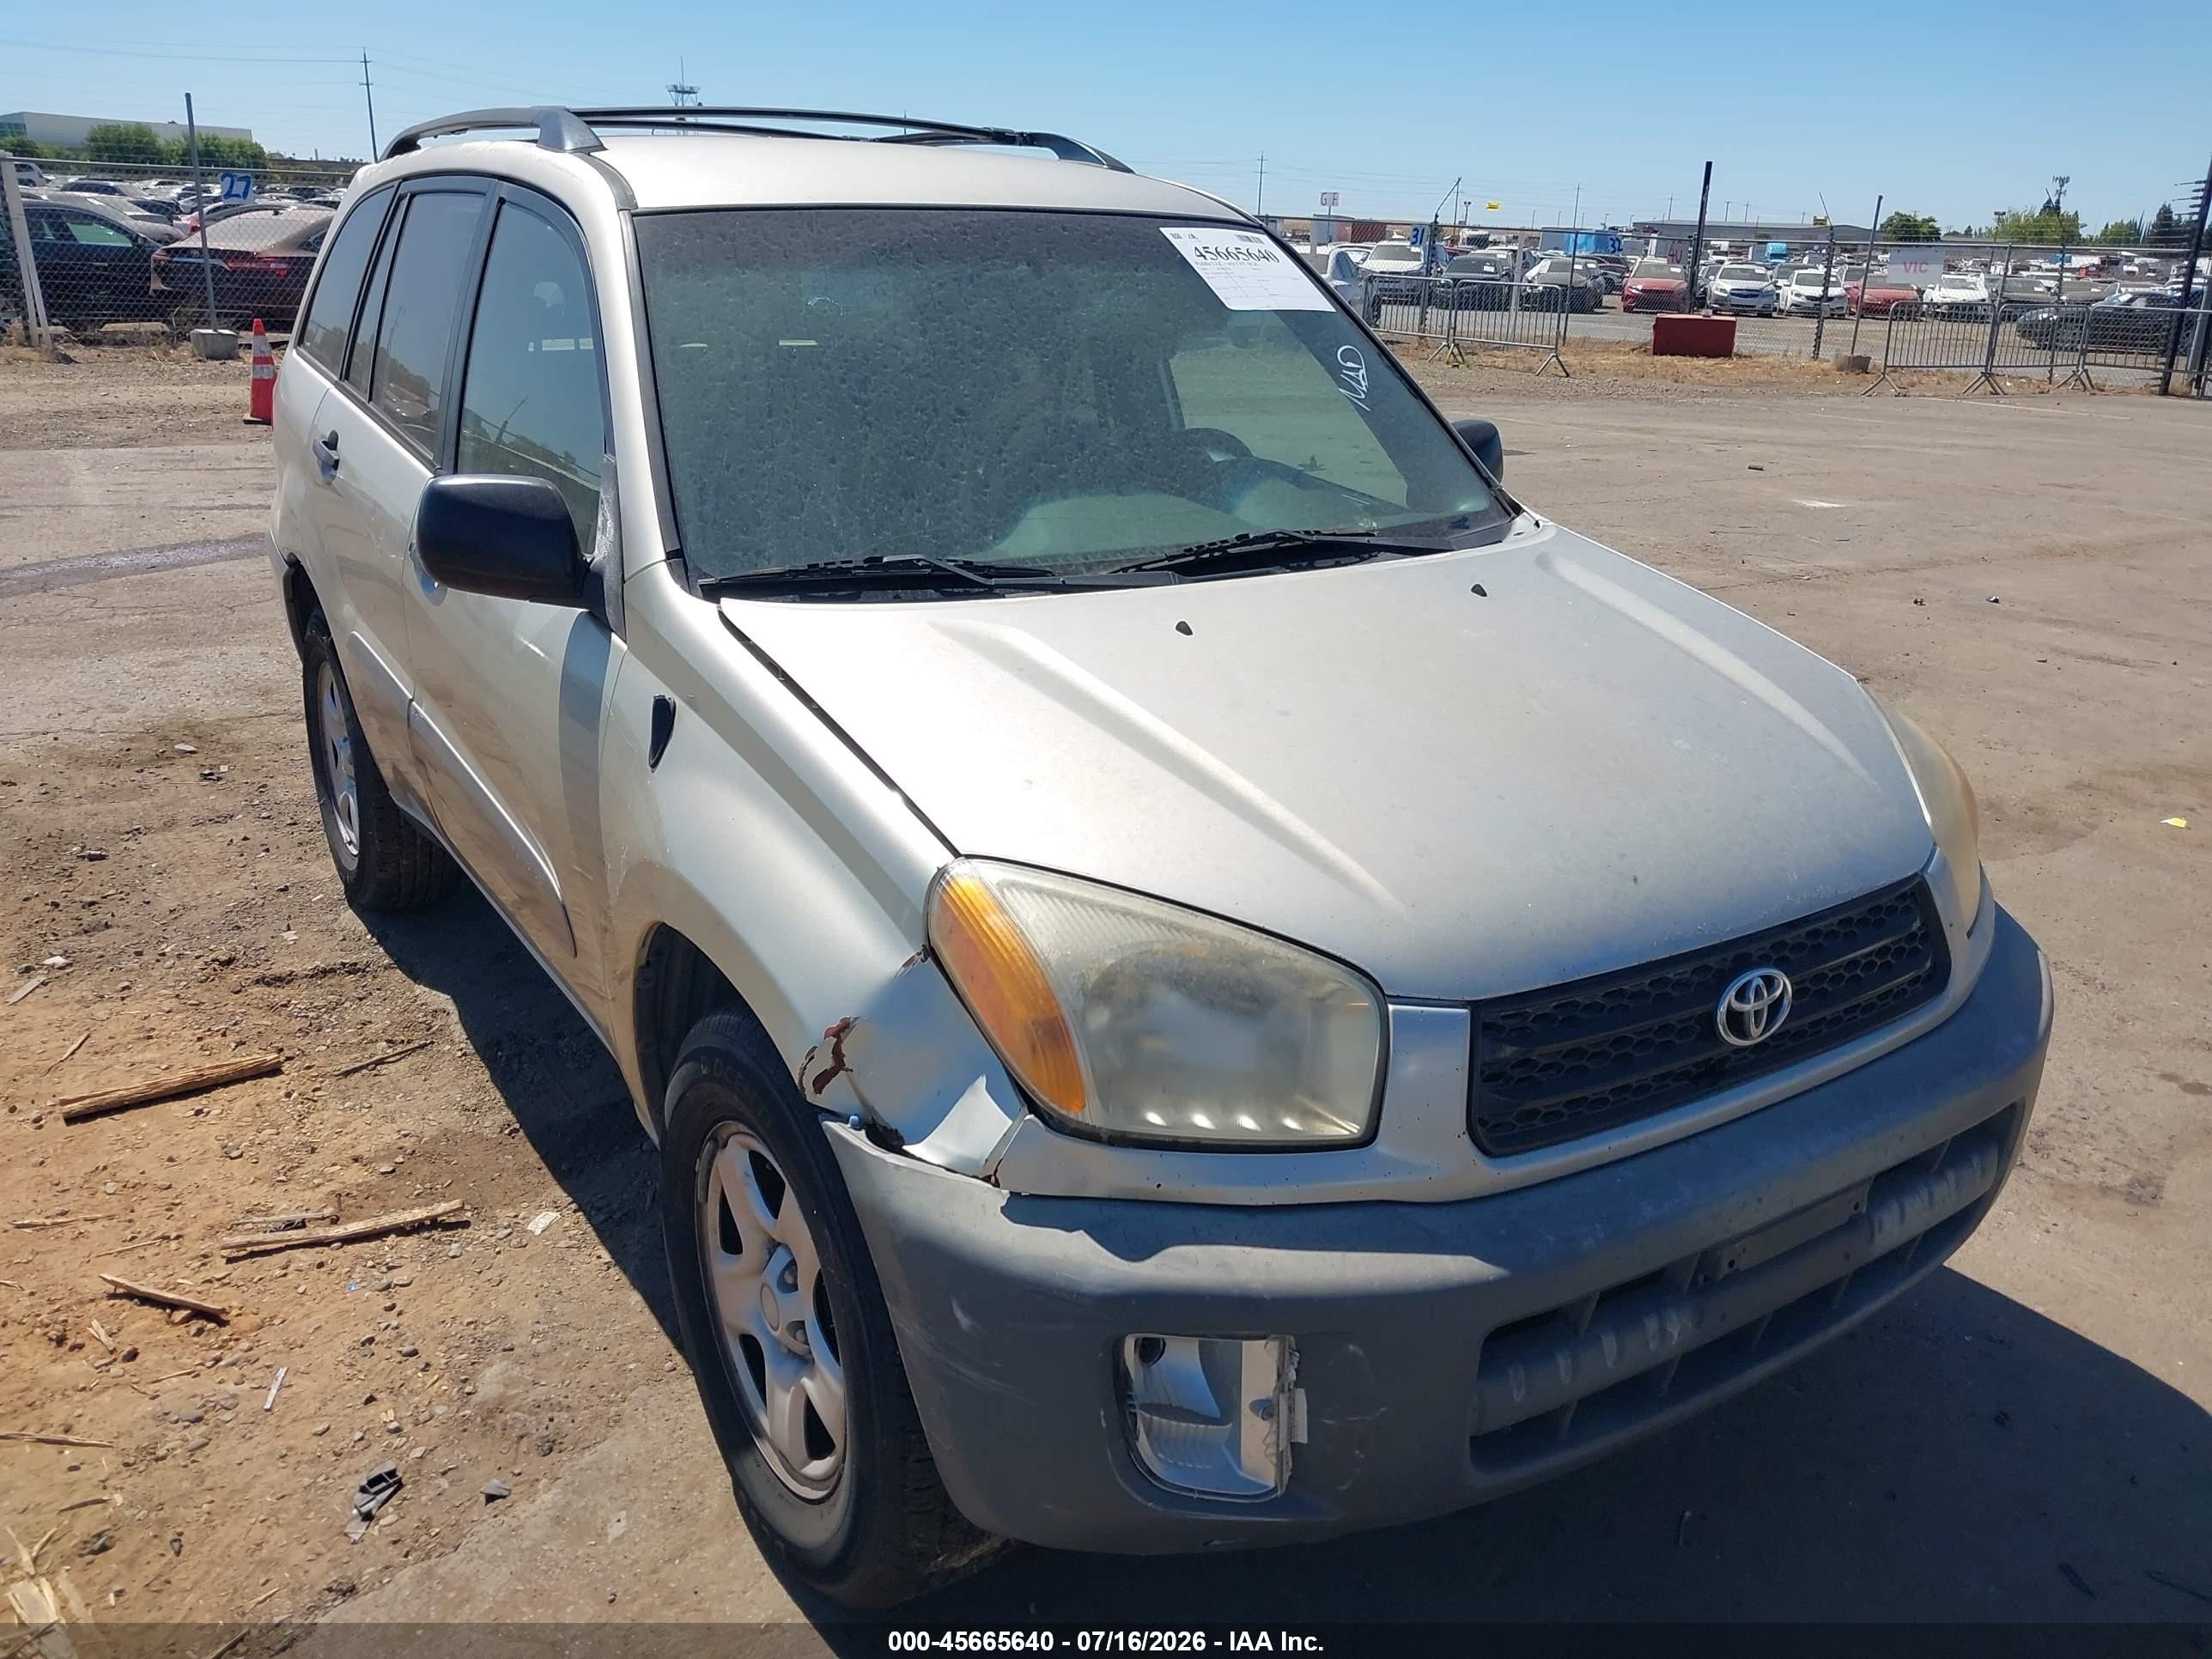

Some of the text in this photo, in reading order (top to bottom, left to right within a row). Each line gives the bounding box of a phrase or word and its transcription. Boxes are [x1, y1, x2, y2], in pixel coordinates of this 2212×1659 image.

[221, 170, 252, 199] 27
[1411, 228, 1425, 246] 31
[1609, 234, 1623, 254] 32
[1193, 245, 1280, 264] 45665640
[1903, 261, 1929, 274] VIC
